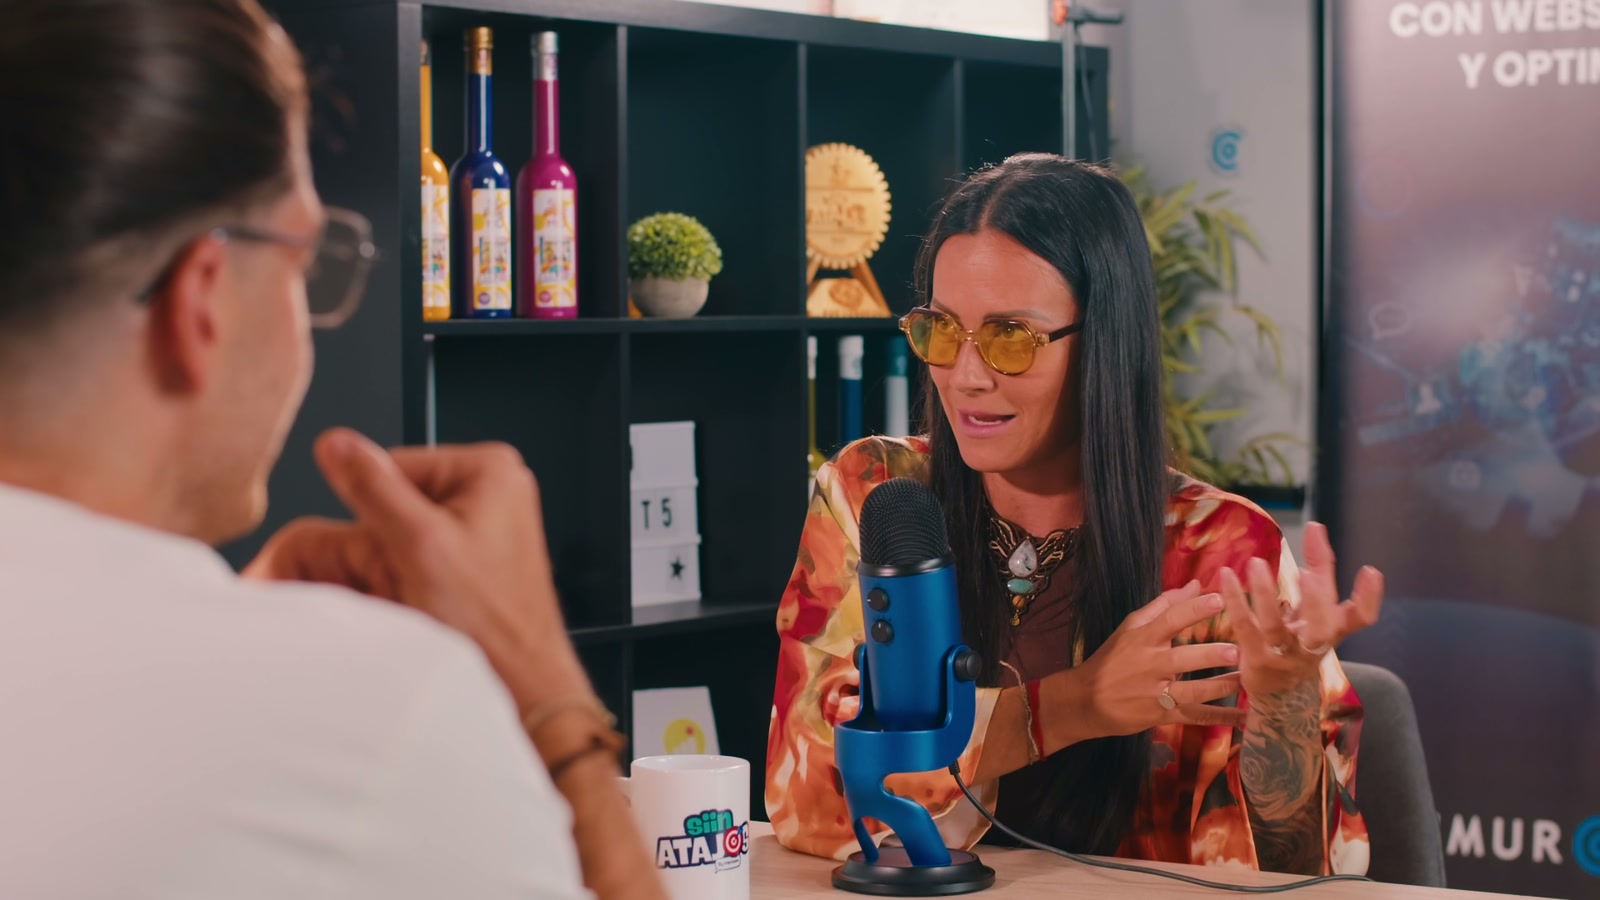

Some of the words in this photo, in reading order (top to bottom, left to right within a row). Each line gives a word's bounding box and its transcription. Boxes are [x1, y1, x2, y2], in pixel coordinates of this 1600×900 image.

[1389, 1, 1483, 37] CON
[1457, 52, 1487, 88] Y
[684, 809, 733, 836] siin
